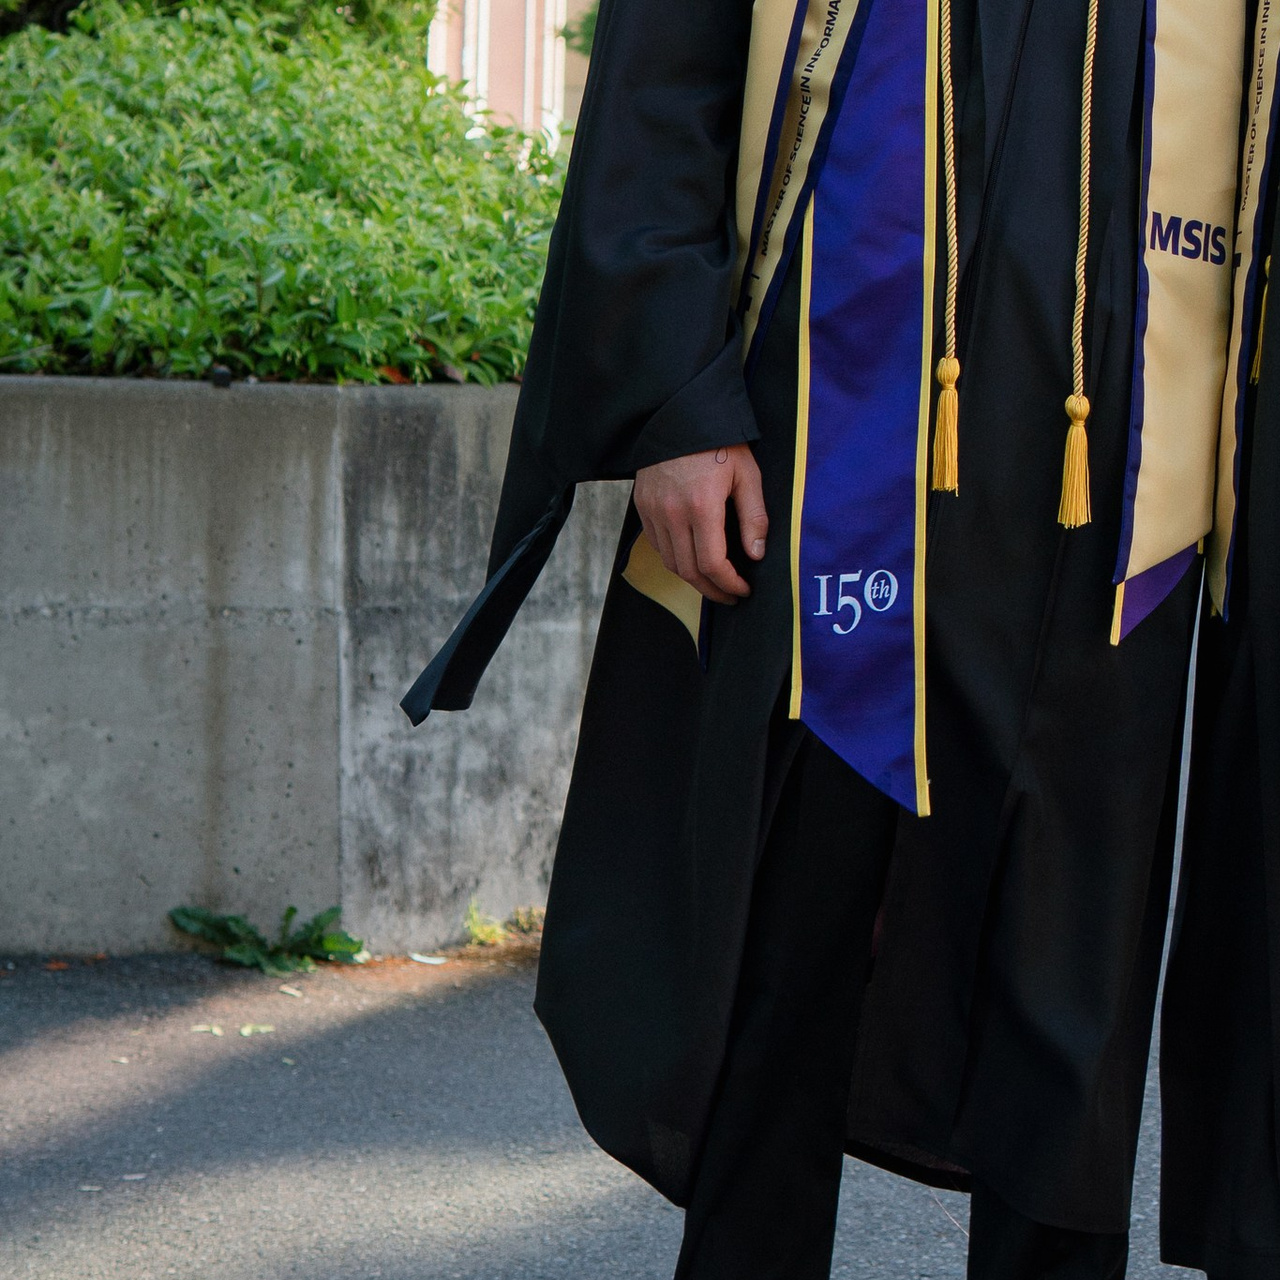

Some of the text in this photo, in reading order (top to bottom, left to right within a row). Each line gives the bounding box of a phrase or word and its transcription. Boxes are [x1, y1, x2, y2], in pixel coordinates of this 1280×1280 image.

[800, 76, 811, 93] IN
[790, 95, 811, 162] SCIENCE
[1241, 143, 1256, 211] MASTER
[1254, 47, 1266, 115] SCIENCE
[1260, 27, 1268, 44] IN
[783, 163, 792, 186] OF
[761, 190, 786, 257] MASTER
[1150, 211, 1227, 266] MSIS
